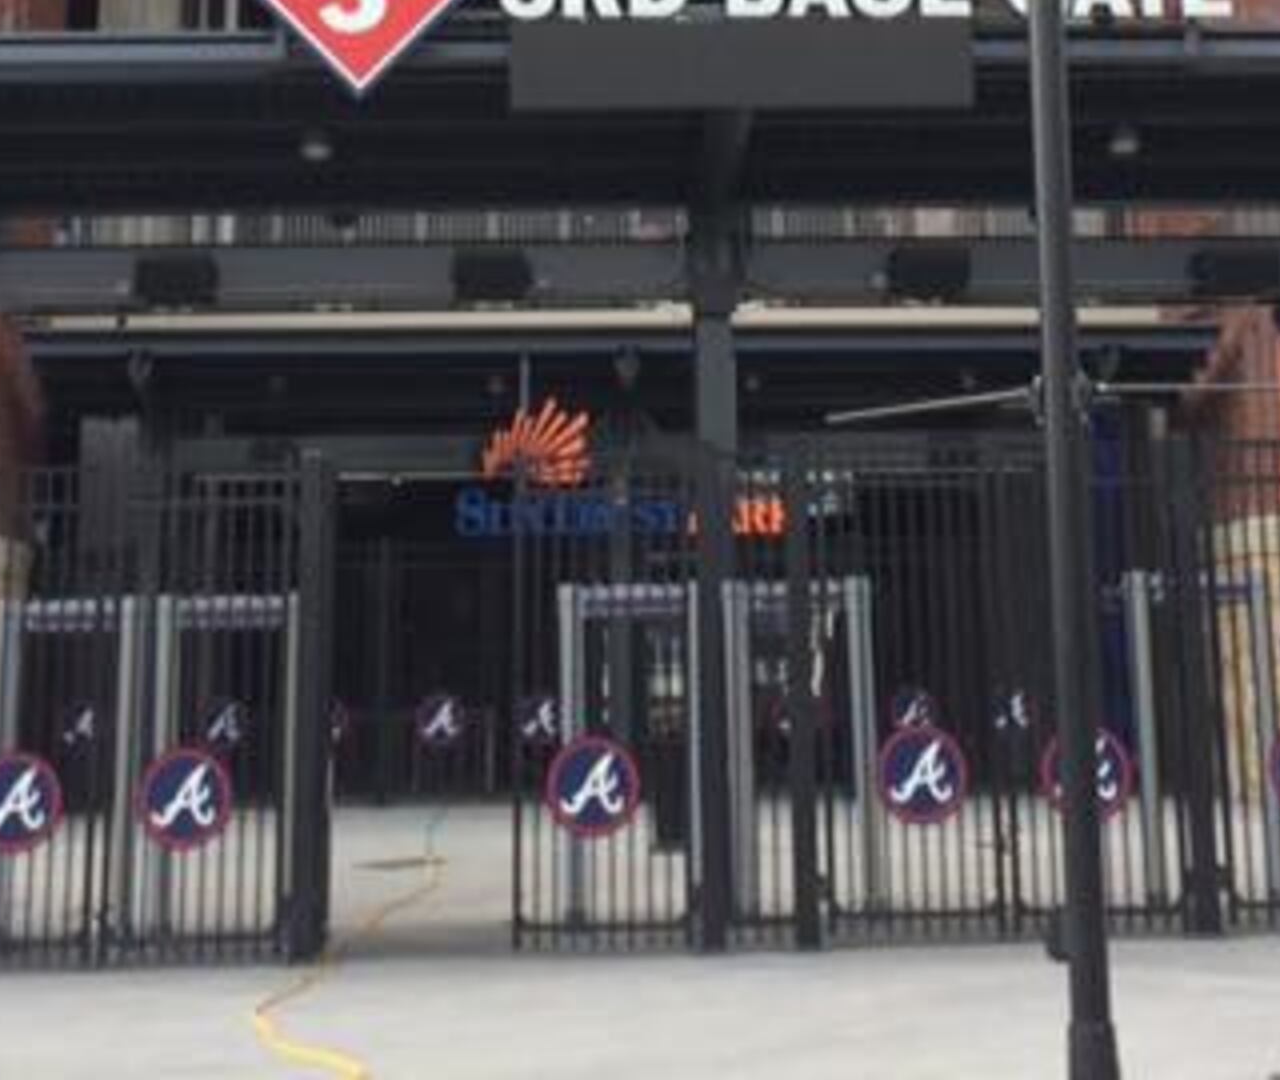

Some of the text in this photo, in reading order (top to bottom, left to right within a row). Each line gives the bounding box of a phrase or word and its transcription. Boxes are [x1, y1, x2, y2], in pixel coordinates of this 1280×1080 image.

[150, 764, 215, 827] A
[560, 753, 624, 815] A
[890, 741, 953, 803] A
